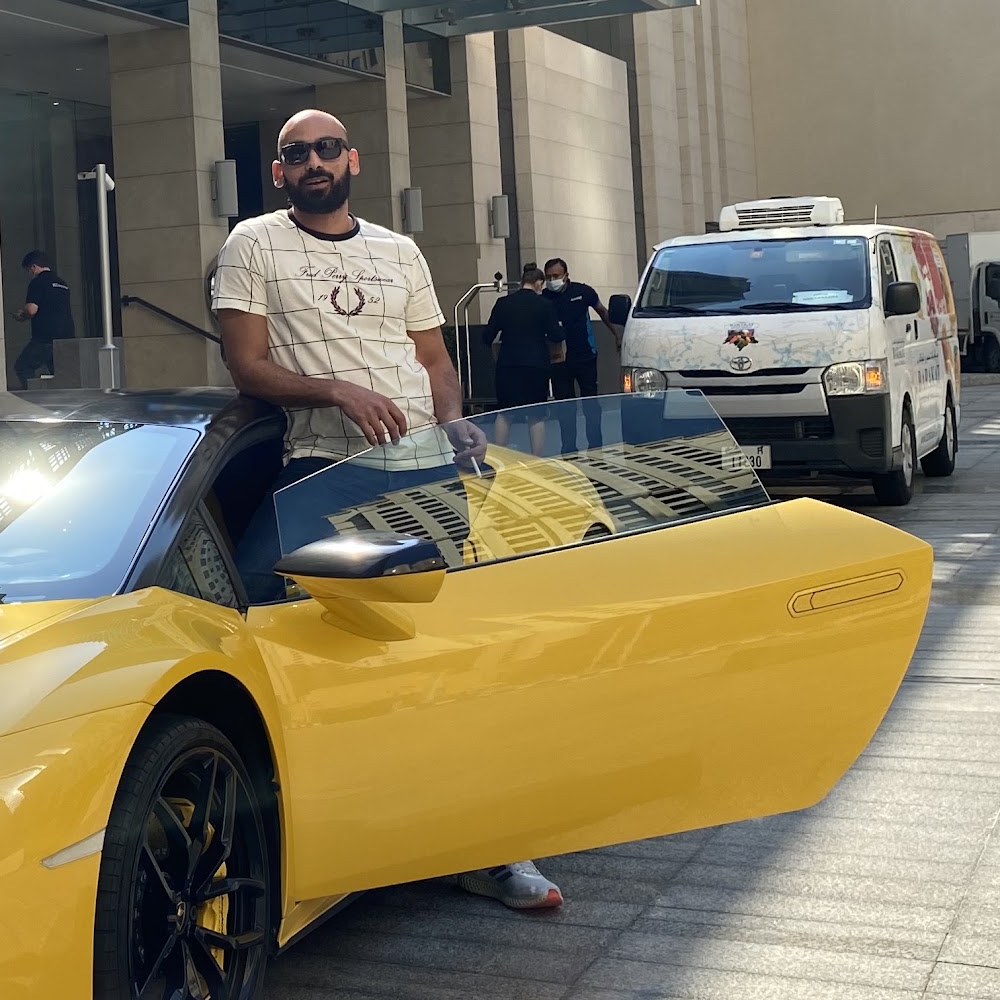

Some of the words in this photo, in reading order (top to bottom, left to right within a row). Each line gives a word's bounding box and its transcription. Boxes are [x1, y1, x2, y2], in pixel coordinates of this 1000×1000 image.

[295, 265, 321, 278] Fred
[317, 294, 328, 302] 19
[367, 296, 381, 304] 52
